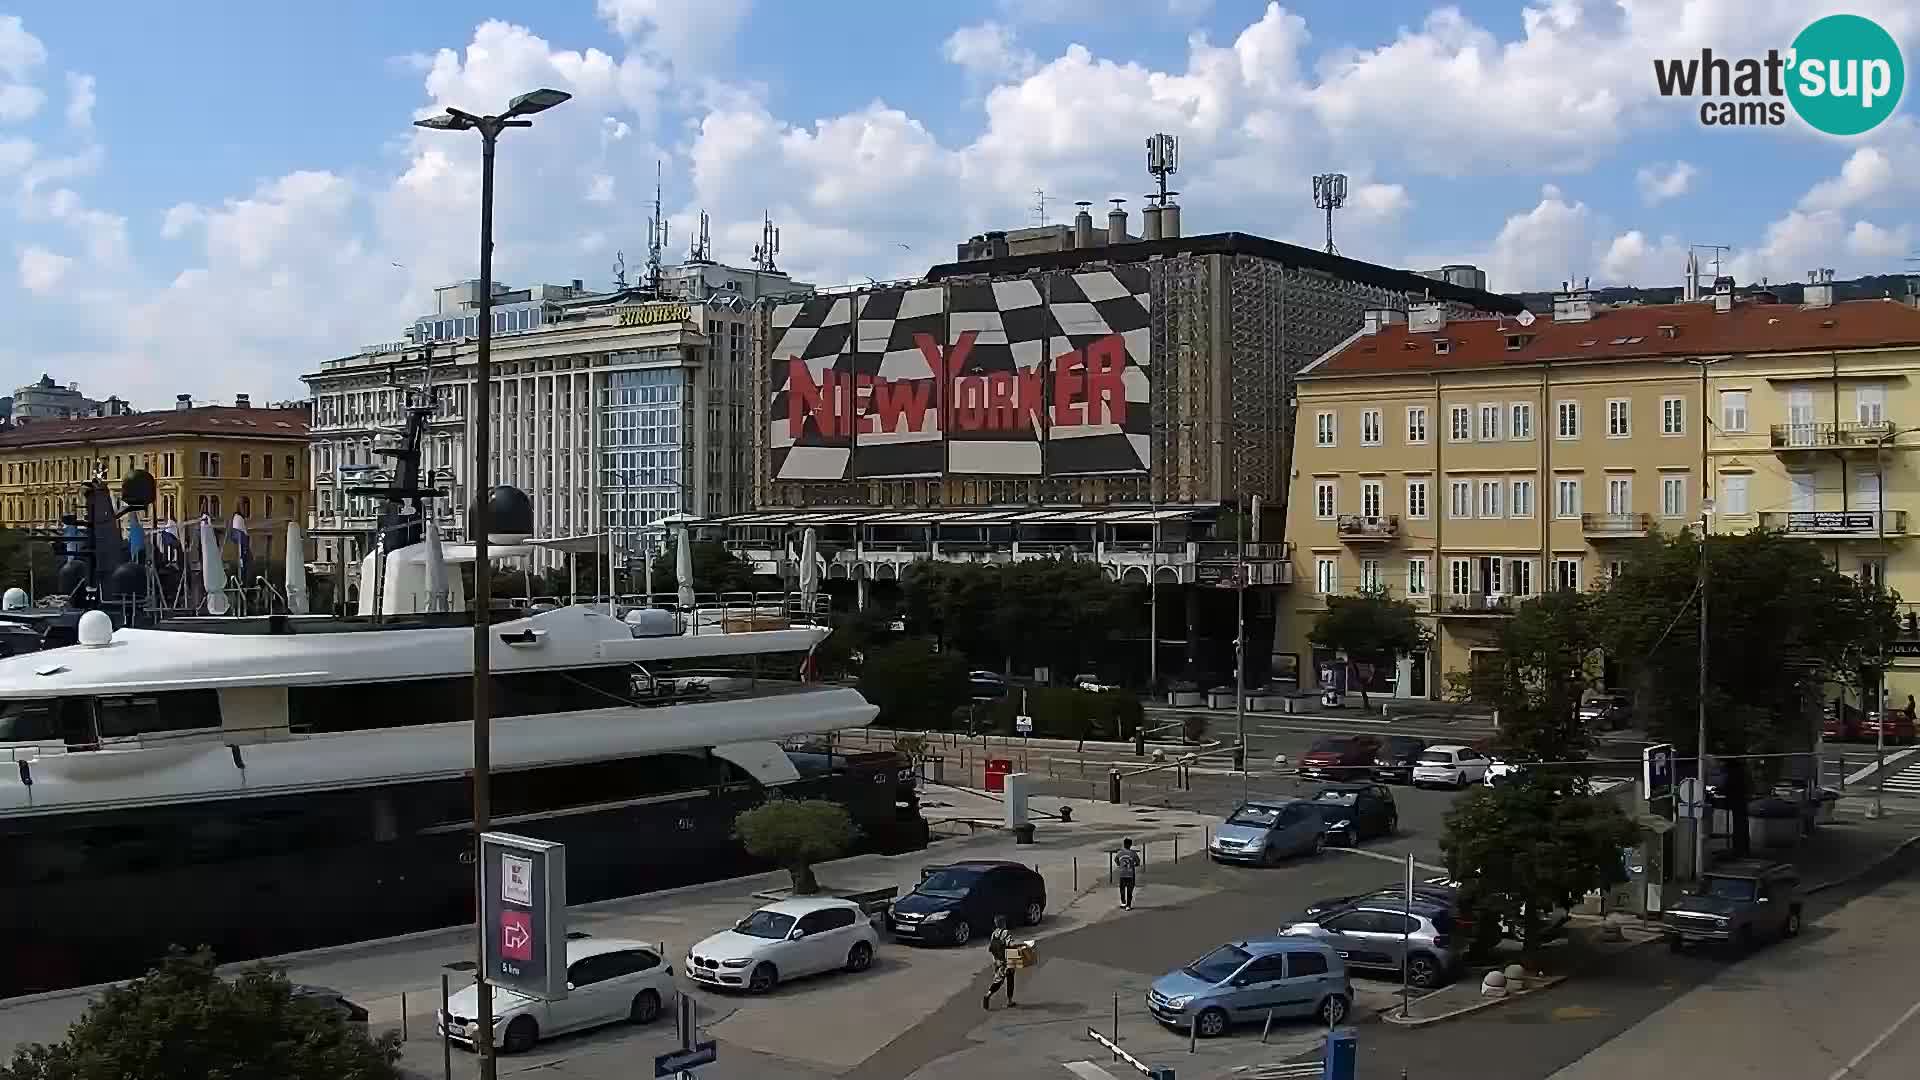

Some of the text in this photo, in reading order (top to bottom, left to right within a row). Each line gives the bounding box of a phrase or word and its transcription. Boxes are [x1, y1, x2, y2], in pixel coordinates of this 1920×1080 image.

[788, 331, 1127, 442] NEW YORKER
[502, 962, 520, 976] 5 km
